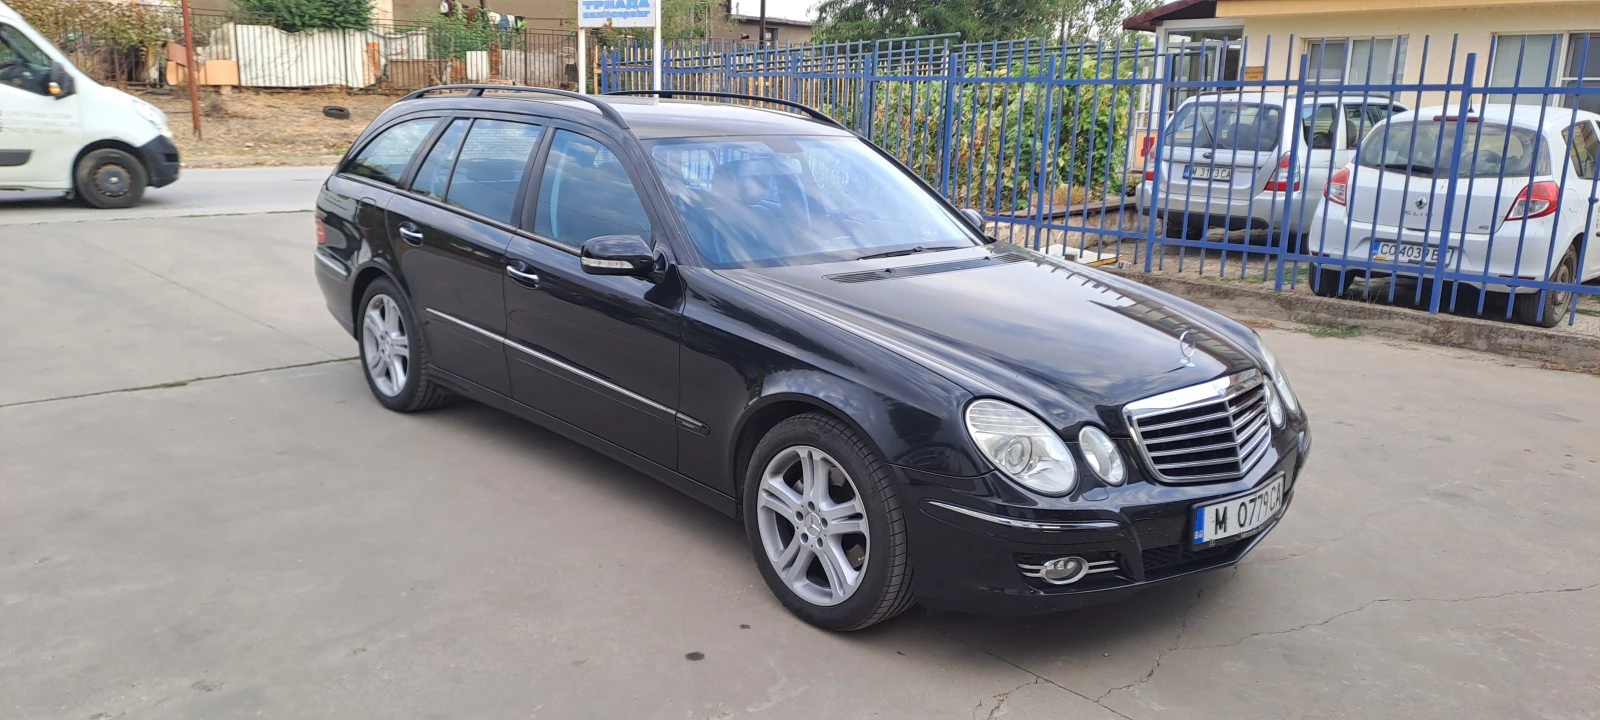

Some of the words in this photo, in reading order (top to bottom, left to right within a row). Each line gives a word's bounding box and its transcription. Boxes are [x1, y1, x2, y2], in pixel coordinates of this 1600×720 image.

[1200, 168, 1219, 178] 313
[1214, 506, 1227, 535] M
[1238, 491, 1269, 528] 0779
